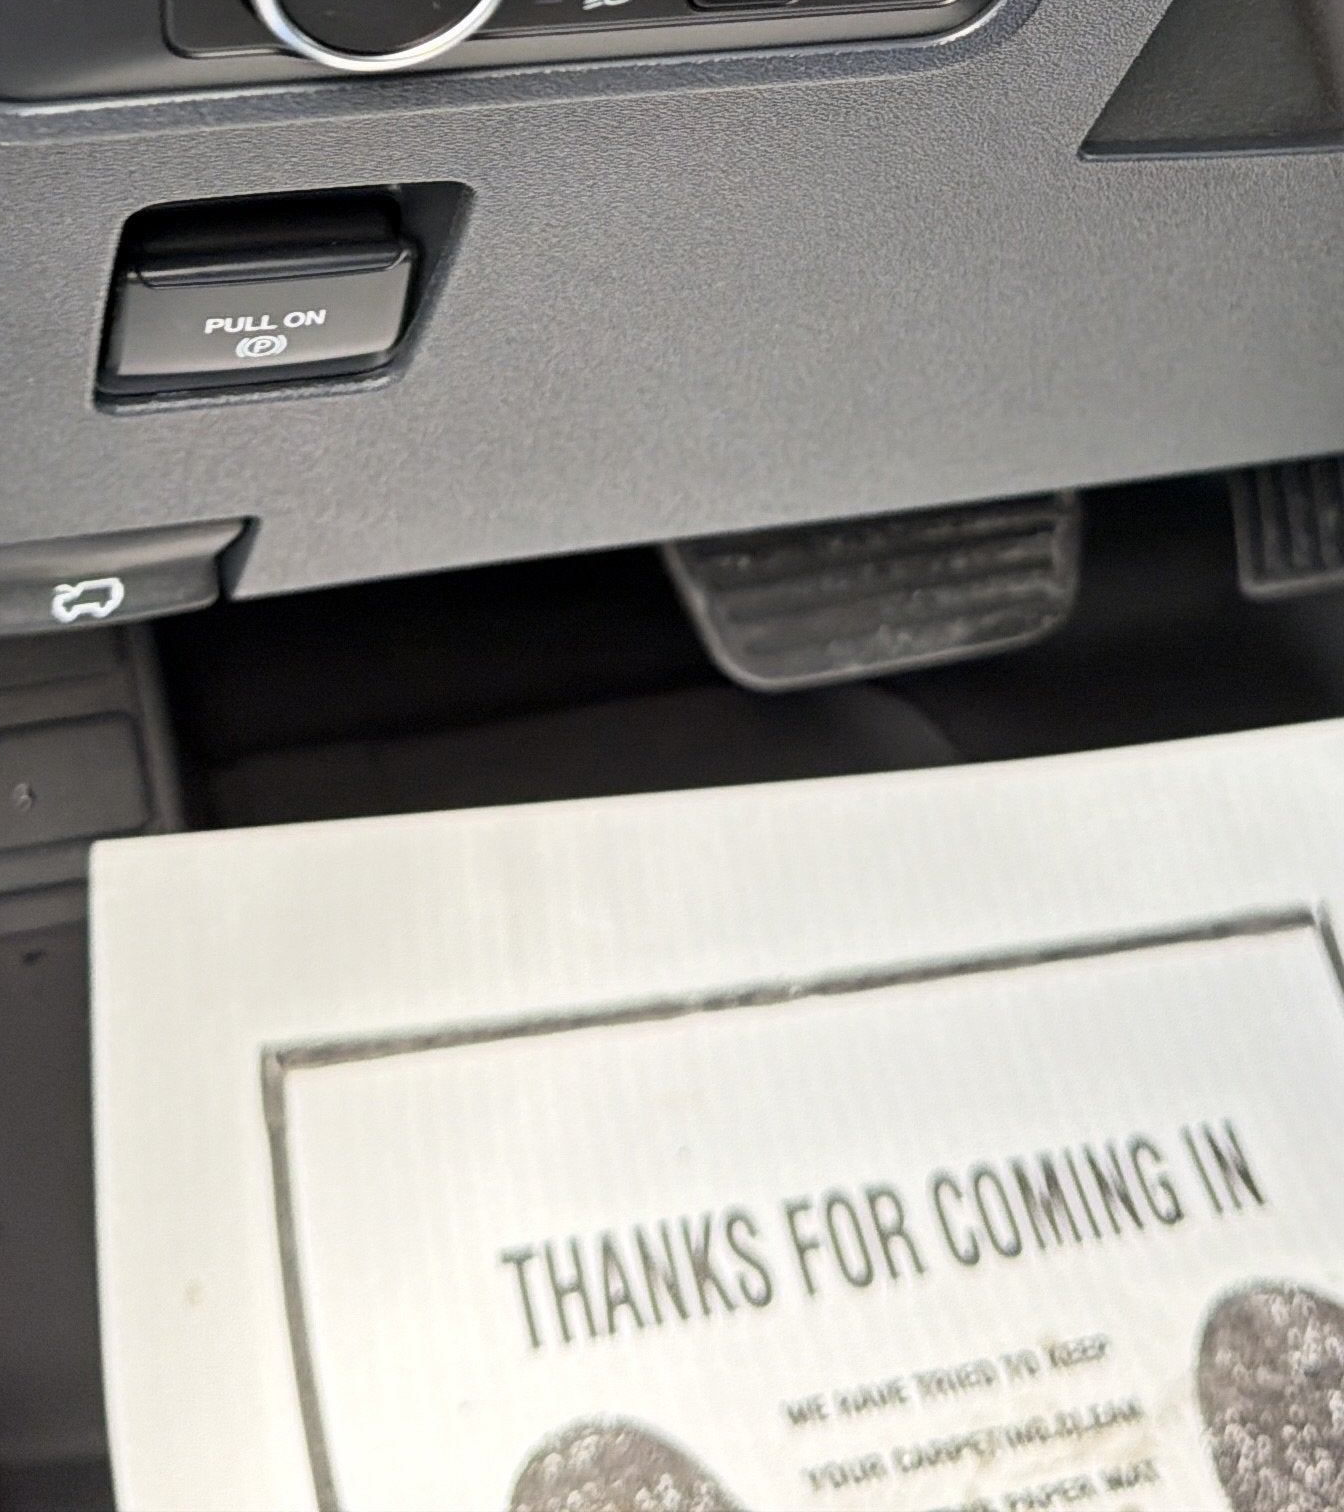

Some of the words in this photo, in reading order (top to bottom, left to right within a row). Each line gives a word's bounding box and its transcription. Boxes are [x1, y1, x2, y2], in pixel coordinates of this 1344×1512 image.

[204, 314, 278, 334] PULL
[283, 309, 327, 328] ON
[499, 1203, 774, 1350] THANKS
[781, 1181, 928, 1297] FOR
[928, 1132, 1185, 1267] COMING
[1179, 1116, 1269, 1216] IN
[784, 1394, 829, 1425] WE
[833, 1377, 908, 1416] HAVE
[911, 1359, 998, 1397] TRIED
[1001, 1348, 1041, 1379] TO
[1047, 1332, 1110, 1369] KEEP
[804, 1452, 888, 1491] YOUR
